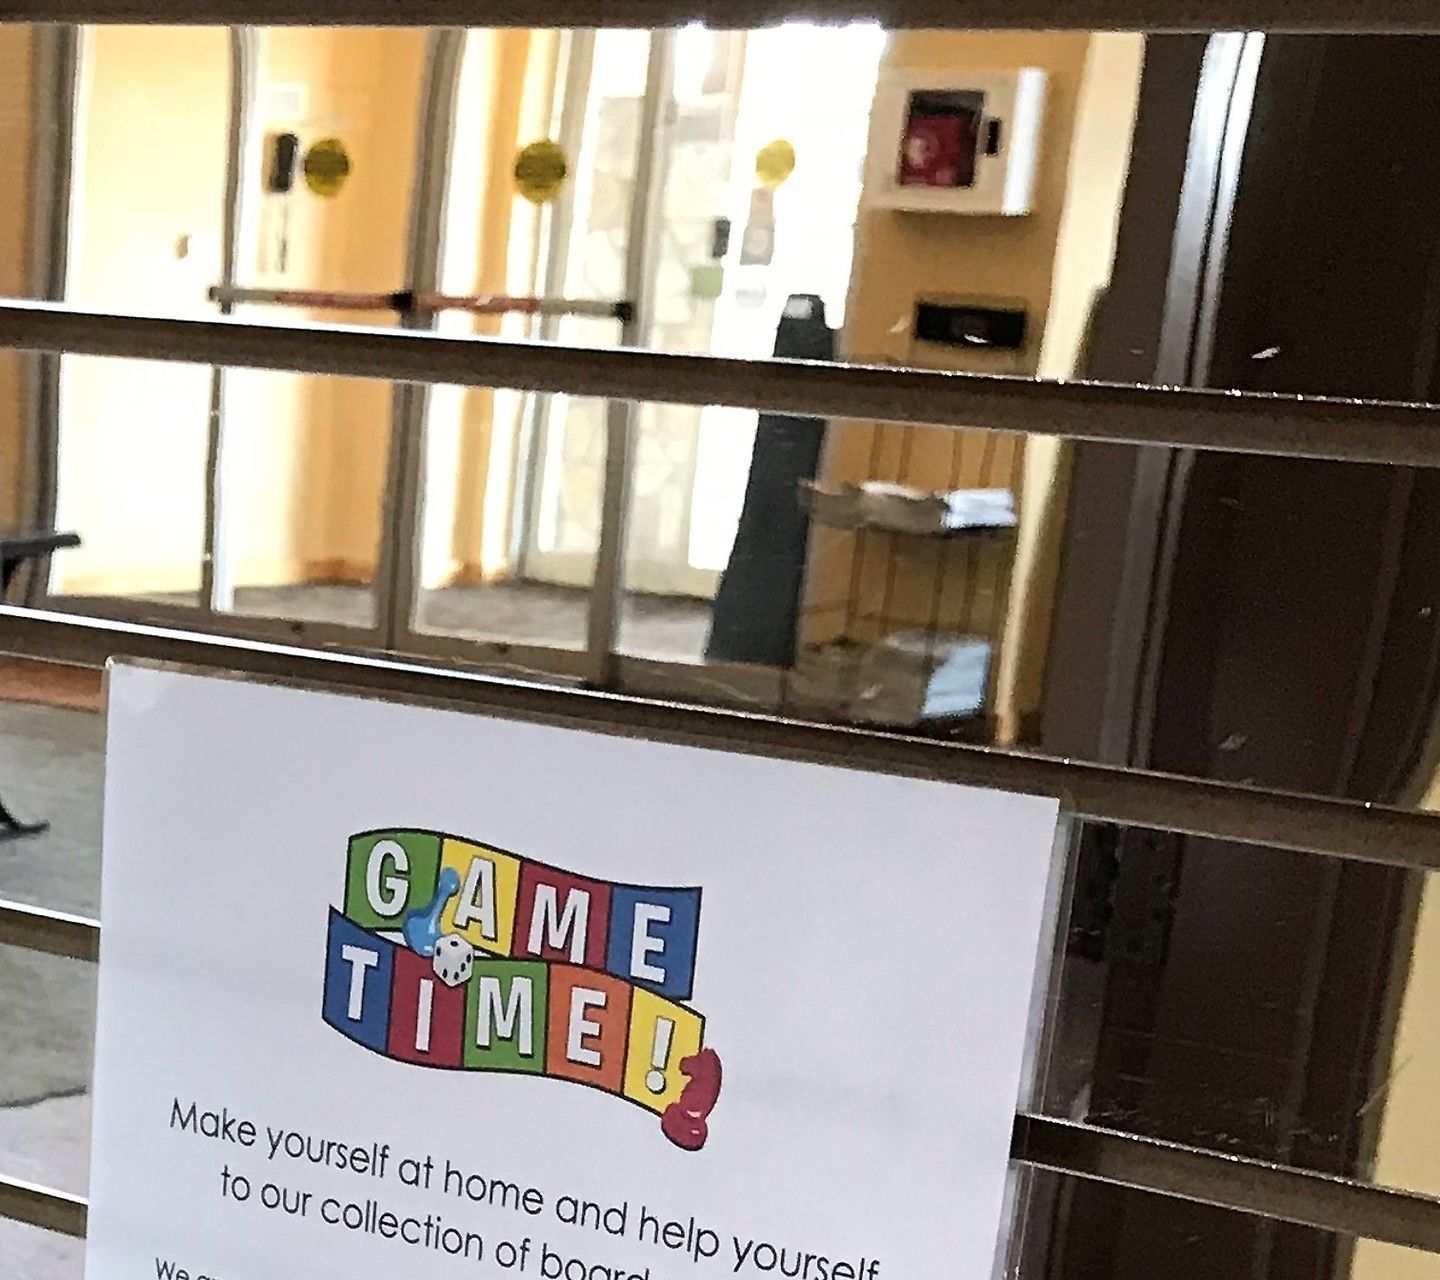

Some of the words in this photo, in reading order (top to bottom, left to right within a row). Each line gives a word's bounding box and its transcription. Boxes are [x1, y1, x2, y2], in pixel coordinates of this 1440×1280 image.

[366, 838, 672, 983] GAME
[341, 944, 675, 1094] TIME!
[168, 1096, 257, 1147] Make
[265, 1126, 390, 1179] yourself
[397, 1153, 434, 1189] at
[443, 1158, 544, 1215] home
[554, 1194, 628, 1237] and
[637, 1204, 720, 1263] help
[220, 1163, 251, 1202] to
[259, 1182, 313, 1217] our
[320, 1197, 483, 1261] collection
[494, 1236, 531, 1272] of
